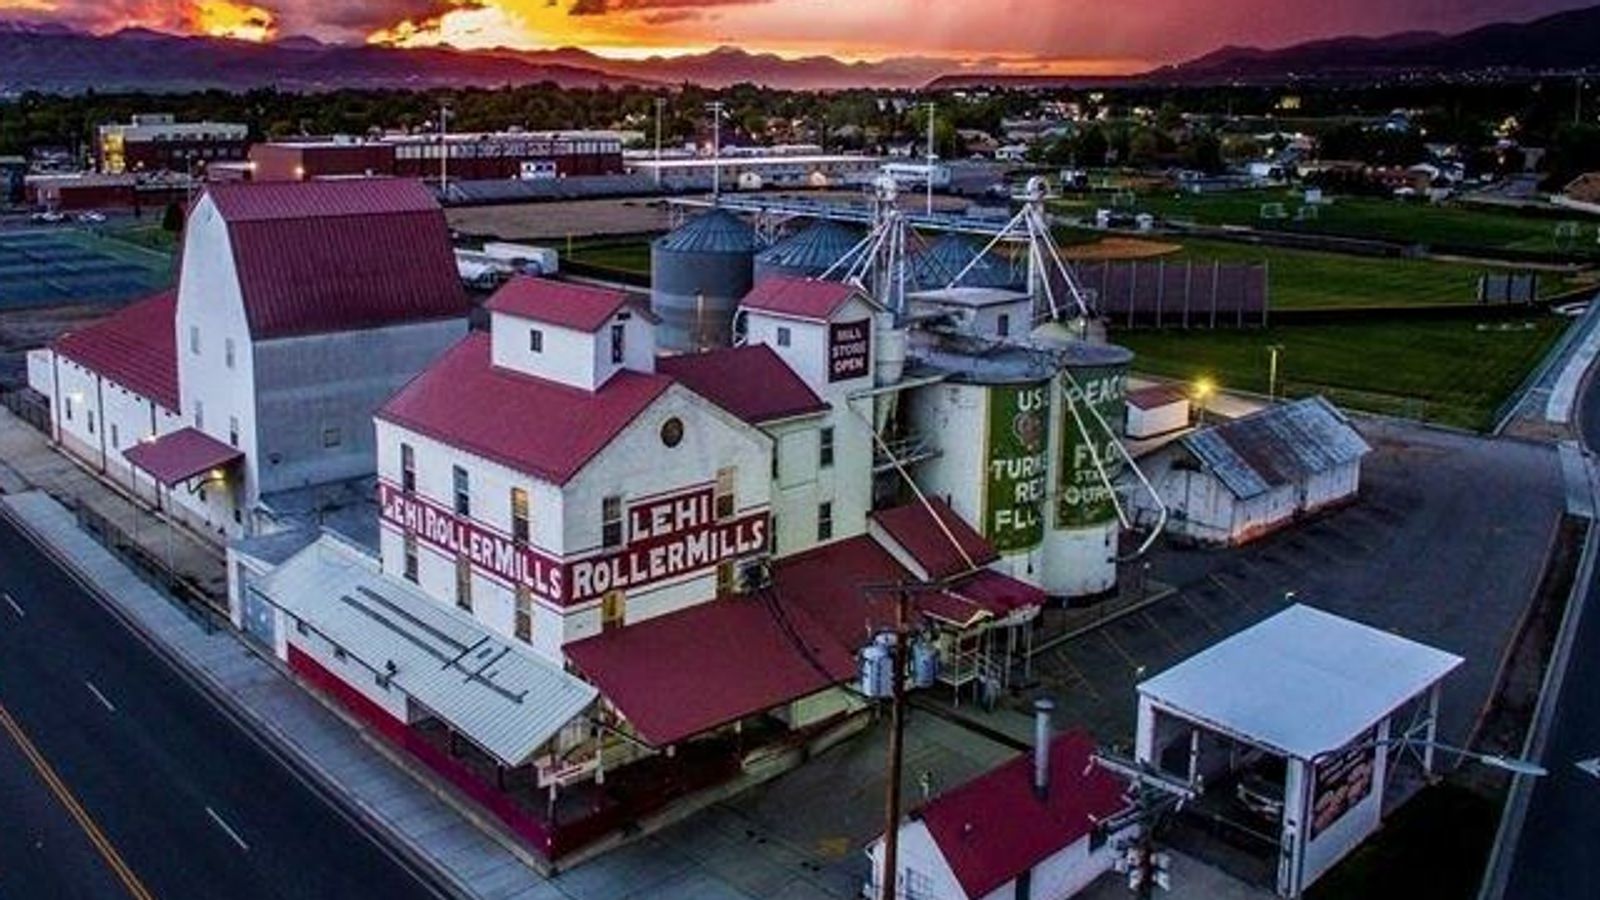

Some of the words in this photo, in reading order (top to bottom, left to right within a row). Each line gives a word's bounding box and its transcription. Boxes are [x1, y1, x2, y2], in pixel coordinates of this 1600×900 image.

[832, 340, 866, 359] STORE
[834, 355, 864, 374] OPEN
[631, 494, 709, 543] LEHI
